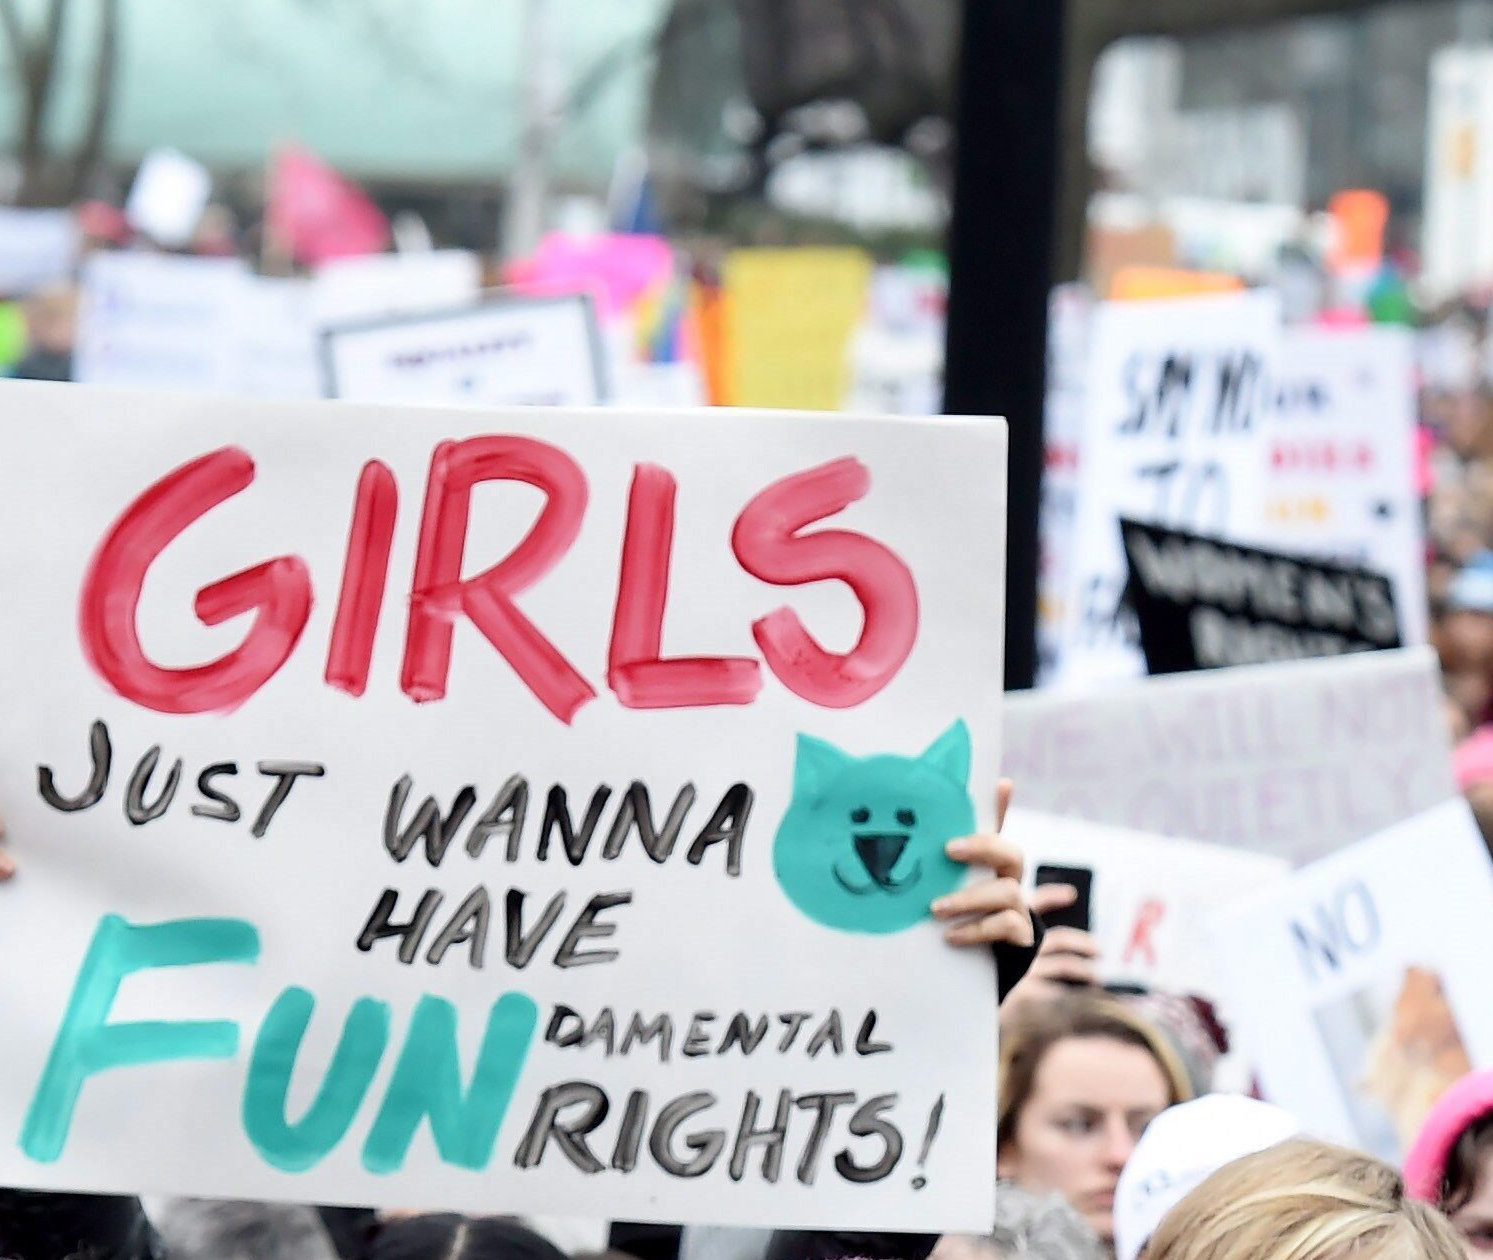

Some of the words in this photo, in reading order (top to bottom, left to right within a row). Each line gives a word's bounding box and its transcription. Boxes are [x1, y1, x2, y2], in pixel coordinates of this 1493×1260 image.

[79, 433, 919, 725] GIRLS
[38, 720, 325, 837] JUST
[383, 776, 755, 876] WANNA
[357, 886, 633, 970] HAVE
[1285, 876, 1383, 985] NO
[17, 911, 539, 1175] FUN
[545, 1005, 893, 1060] DAMENTAL
[513, 1081, 945, 1190] RIGHTS!
